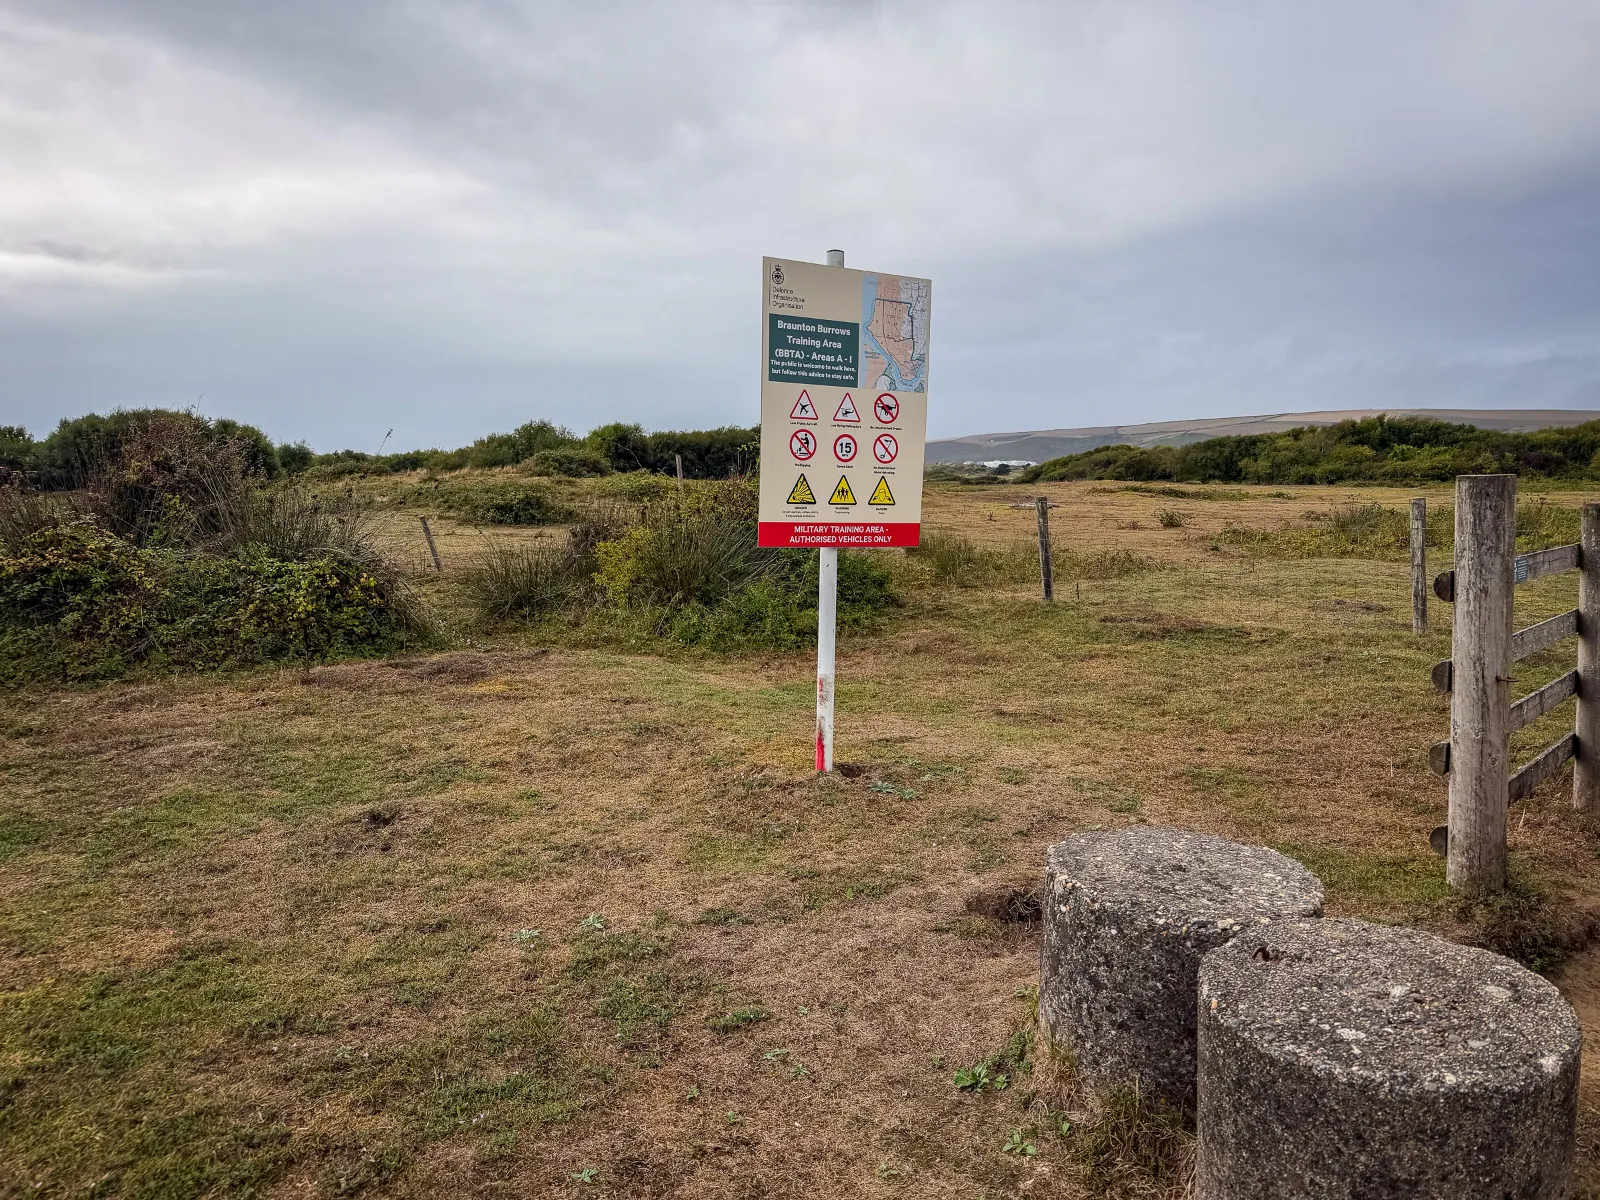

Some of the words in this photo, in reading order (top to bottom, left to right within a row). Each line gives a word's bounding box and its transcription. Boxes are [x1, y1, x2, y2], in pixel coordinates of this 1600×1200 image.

[778, 320, 815, 332] Braunton
[818, 325, 850, 335] Burrows
[787, 335, 821, 348] Training
[823, 339, 842, 348] Area
[775, 348, 804, 359] (BBTA)
[811, 352, 835, 362] Areas
[840, 442, 851, 453] 15
